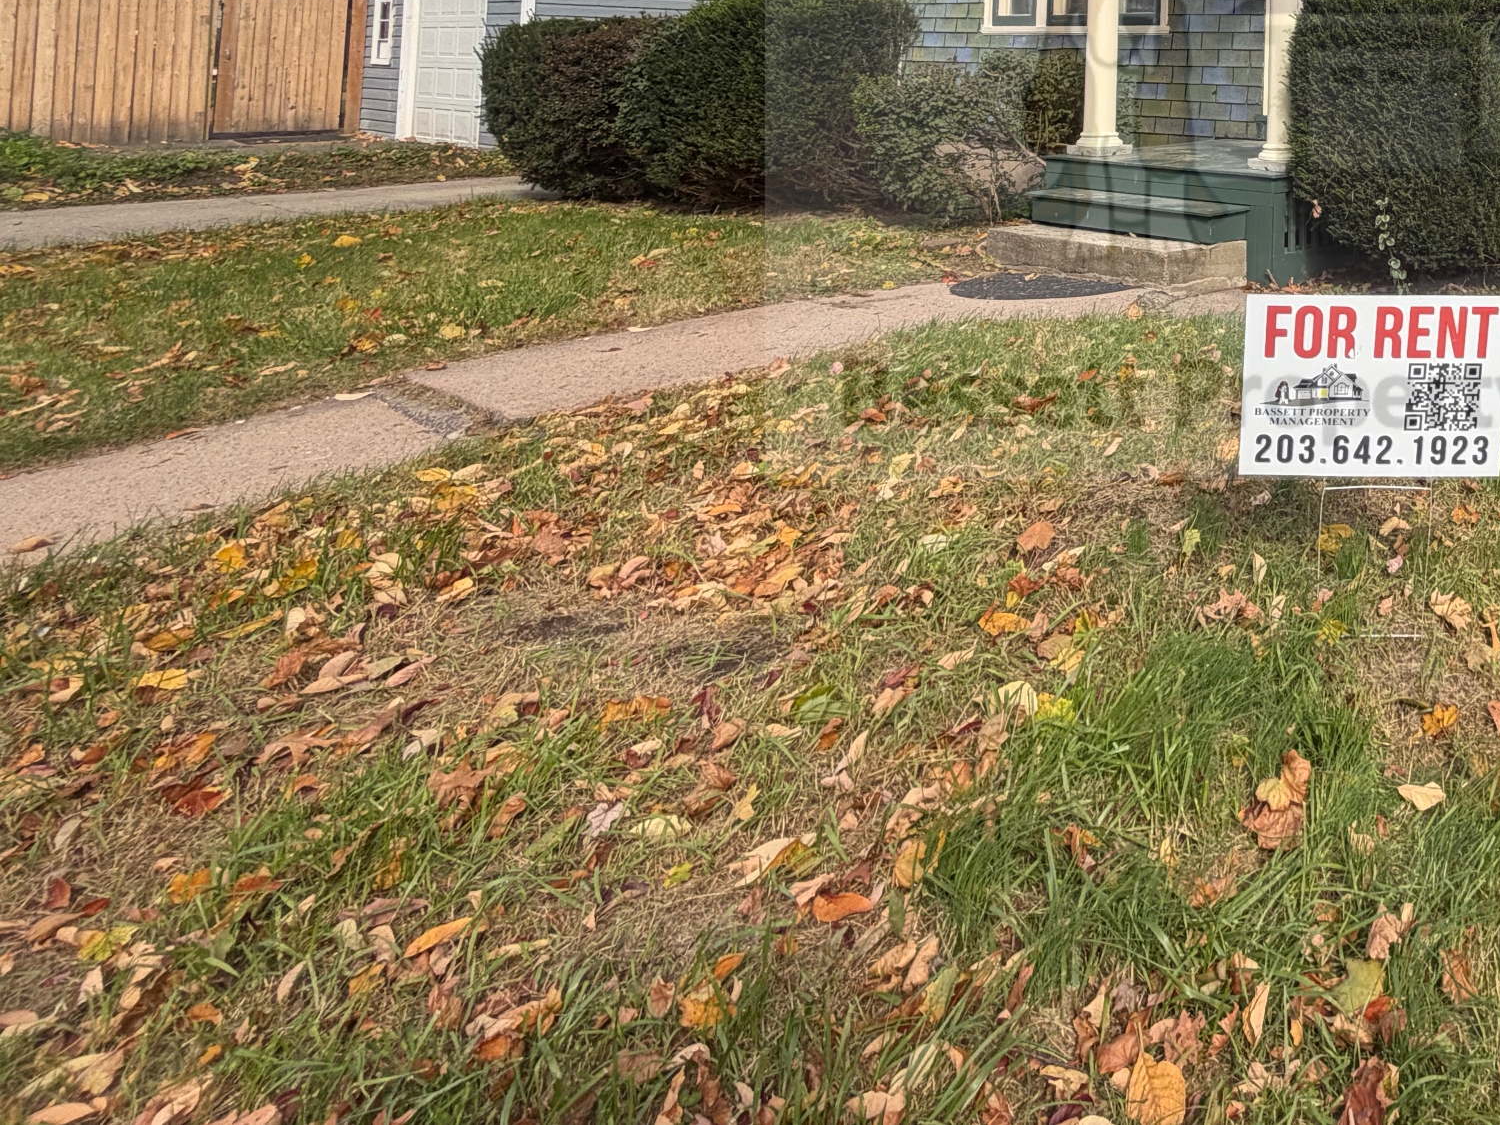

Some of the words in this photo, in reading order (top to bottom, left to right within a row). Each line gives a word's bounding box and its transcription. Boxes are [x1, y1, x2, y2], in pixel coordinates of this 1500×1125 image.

[1264, 305, 1357, 359] FOR
[1373, 305, 1499, 359] RENT
[1254, 407, 1307, 416] BASSETT
[1309, 408, 1371, 417] PROPERTY
[1269, 417, 1356, 426] MANAGEMENT
[1254, 434, 1490, 465] 203.642.1923
